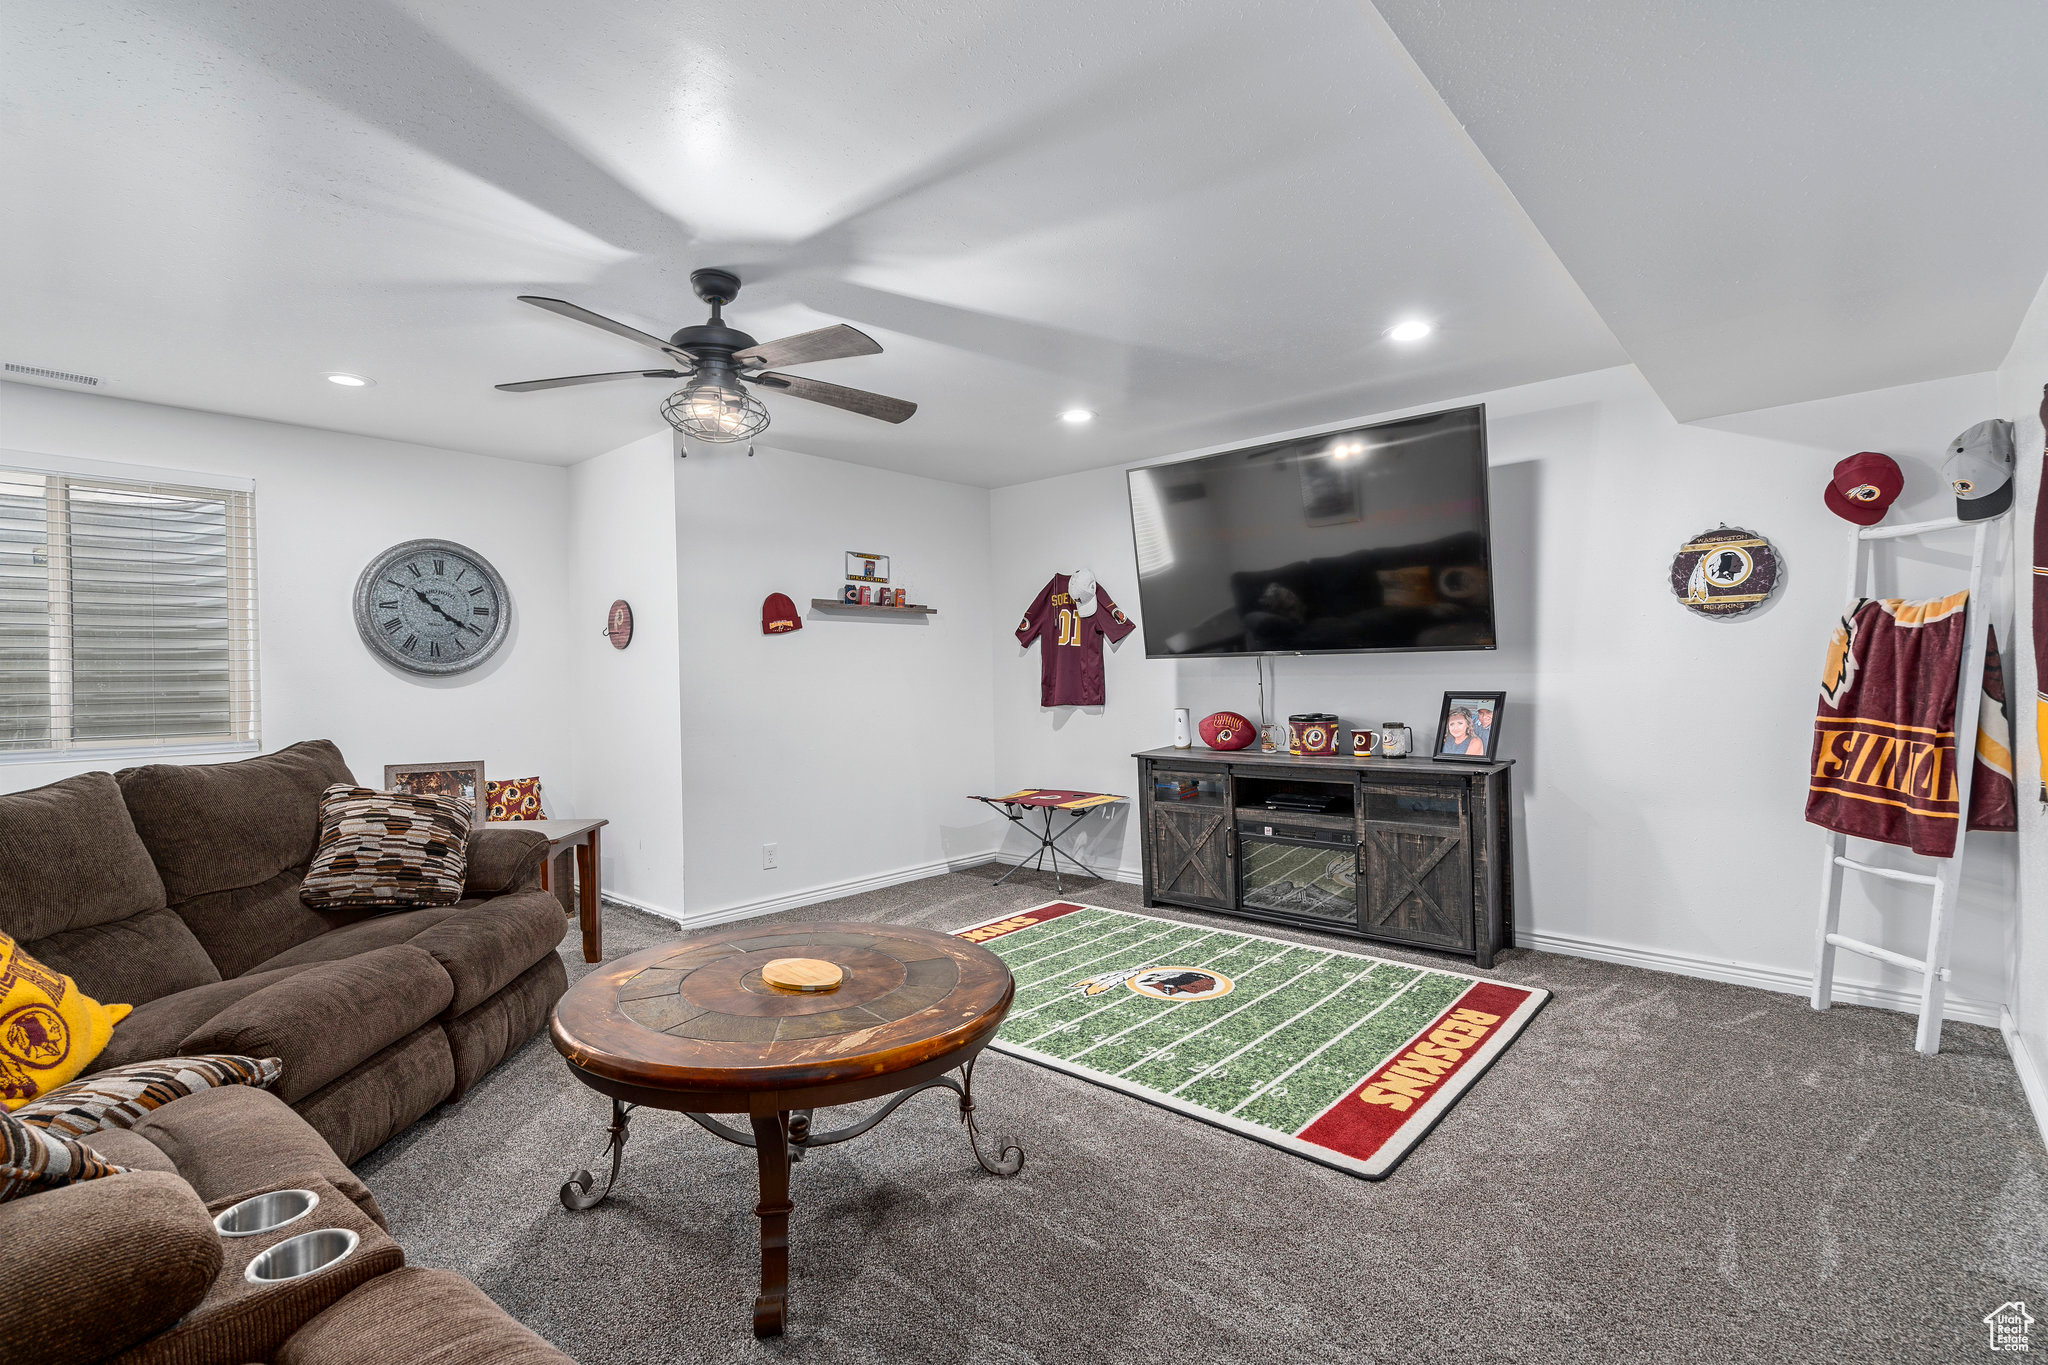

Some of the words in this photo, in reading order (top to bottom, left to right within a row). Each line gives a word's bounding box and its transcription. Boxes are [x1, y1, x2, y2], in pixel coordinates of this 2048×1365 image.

[1696, 534, 1748, 543] WASHINGTON
[474, 607, 489, 616] III
[1359, 1007, 1501, 1112] REDSKINS
